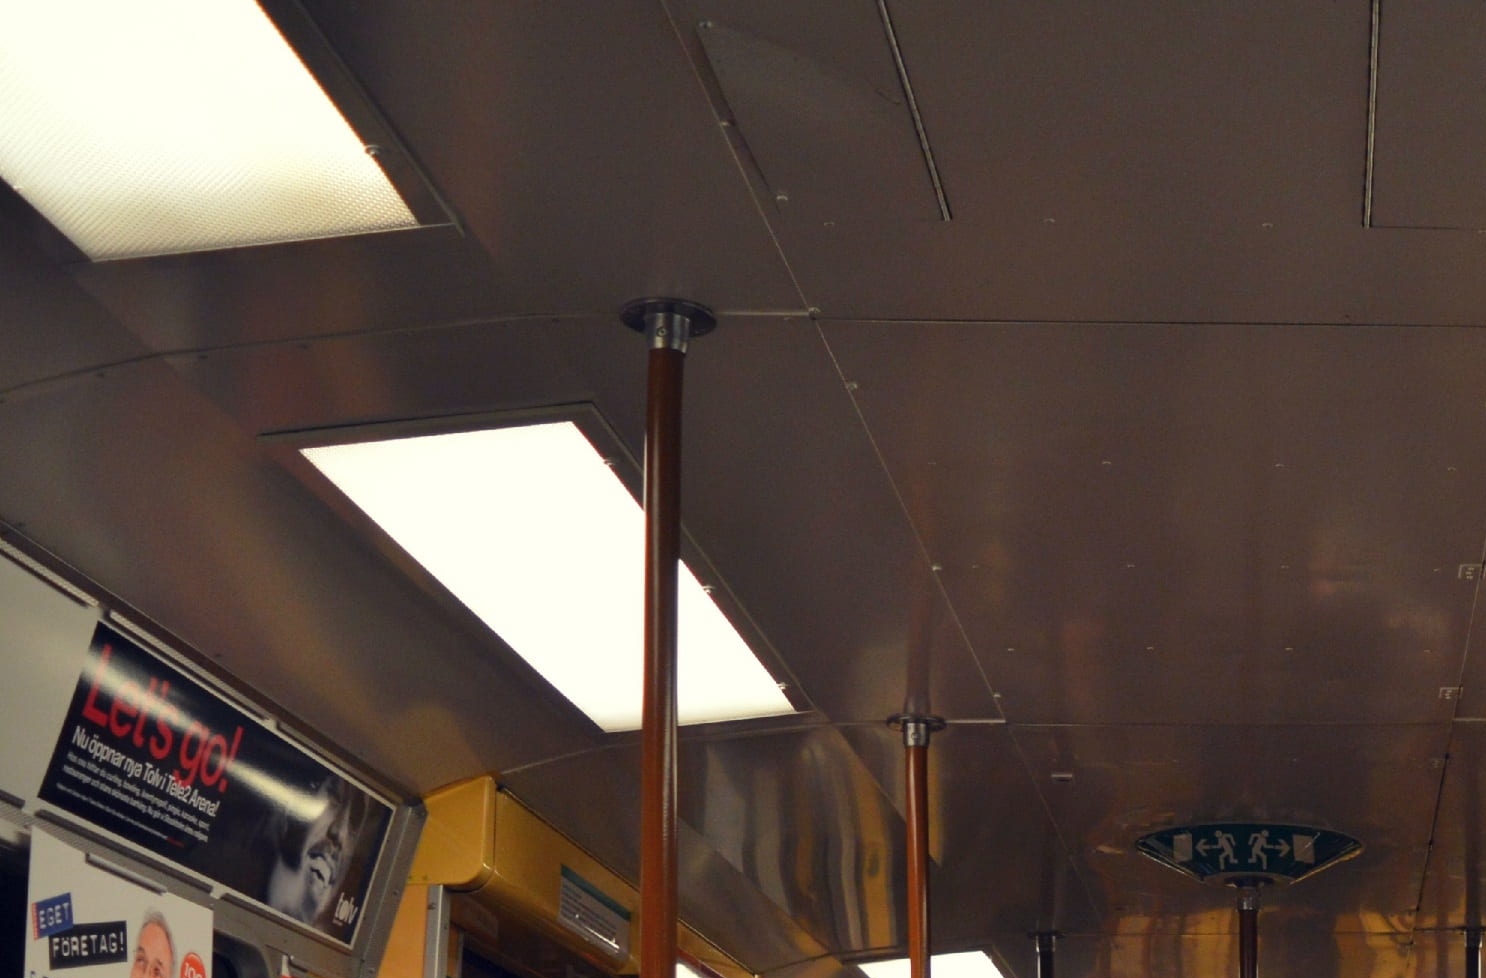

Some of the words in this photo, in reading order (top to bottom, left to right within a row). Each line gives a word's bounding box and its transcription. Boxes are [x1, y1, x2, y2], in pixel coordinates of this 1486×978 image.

[82, 643, 174, 760] Let's
[177, 724, 244, 793] go!
[72, 725, 90, 750] Nu
[87, 735, 126, 767] öppnar
[123, 756, 144, 778] nya
[143, 761, 163, 788] Tolv
[166, 774, 192, 802] Tele2
[188, 783, 221, 817] Arena!
[38, 901, 71, 931] EGET
[334, 891, 359, 925] tolv
[51, 931, 125, 960] FÖRETAG!
